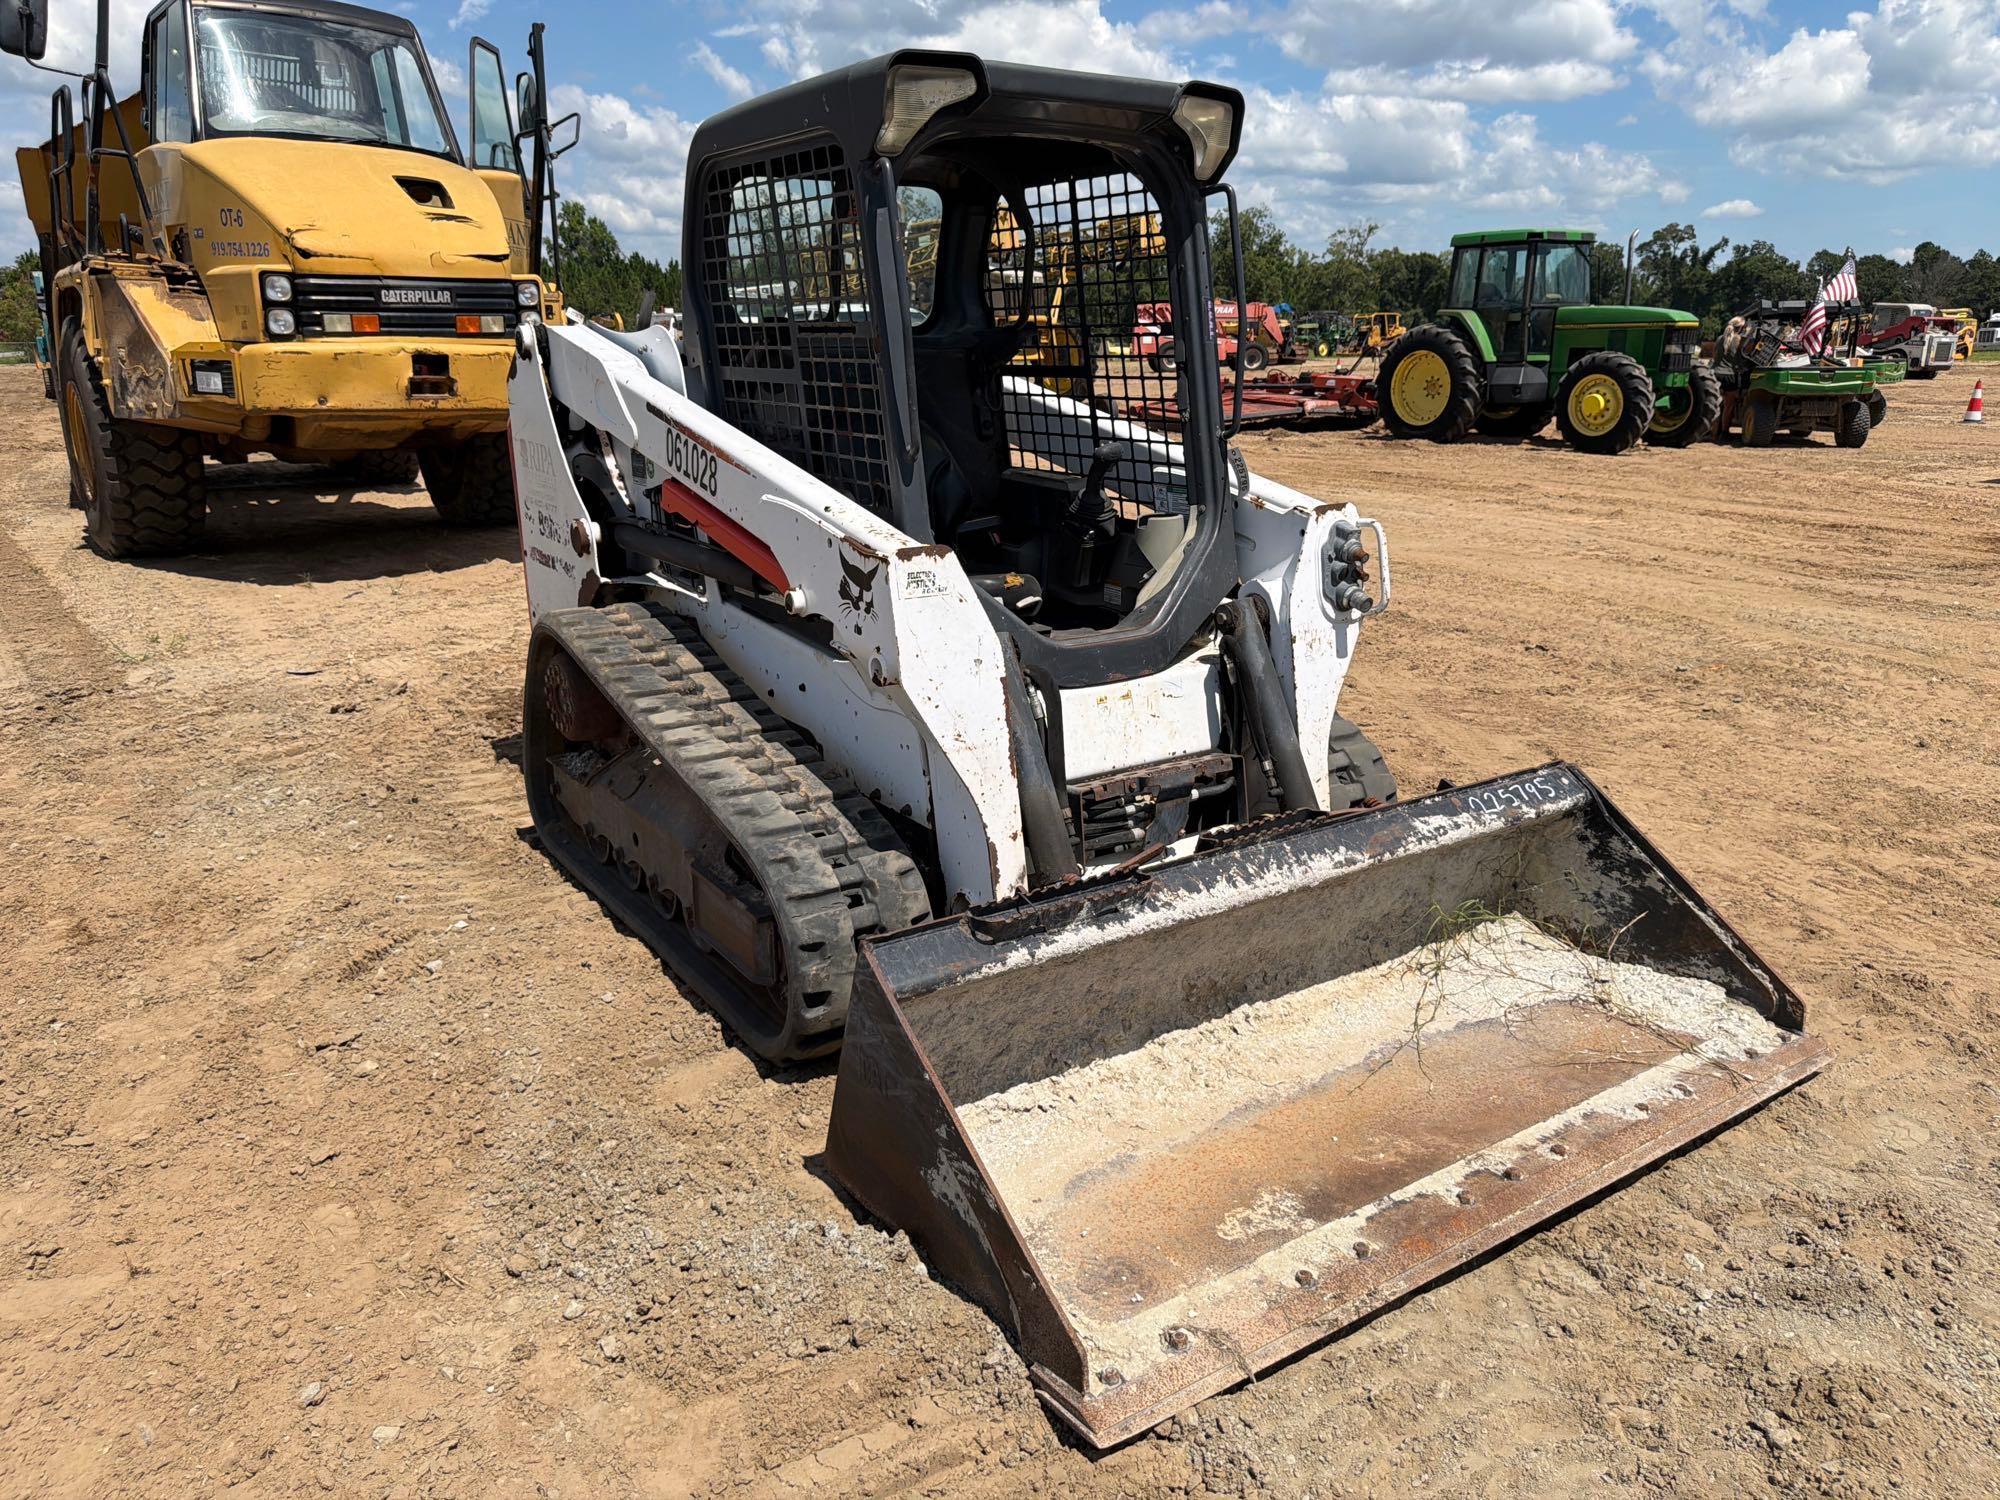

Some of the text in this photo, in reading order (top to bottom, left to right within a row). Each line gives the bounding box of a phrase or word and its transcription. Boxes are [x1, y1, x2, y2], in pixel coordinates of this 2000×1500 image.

[220, 208, 243, 227] OT-6
[210, 242, 270, 258] 919.754.1226
[381, 289, 452, 304] CATERPILLAR
[666, 427, 717, 497] 061028
[1469, 777, 1556, 814] 225795
